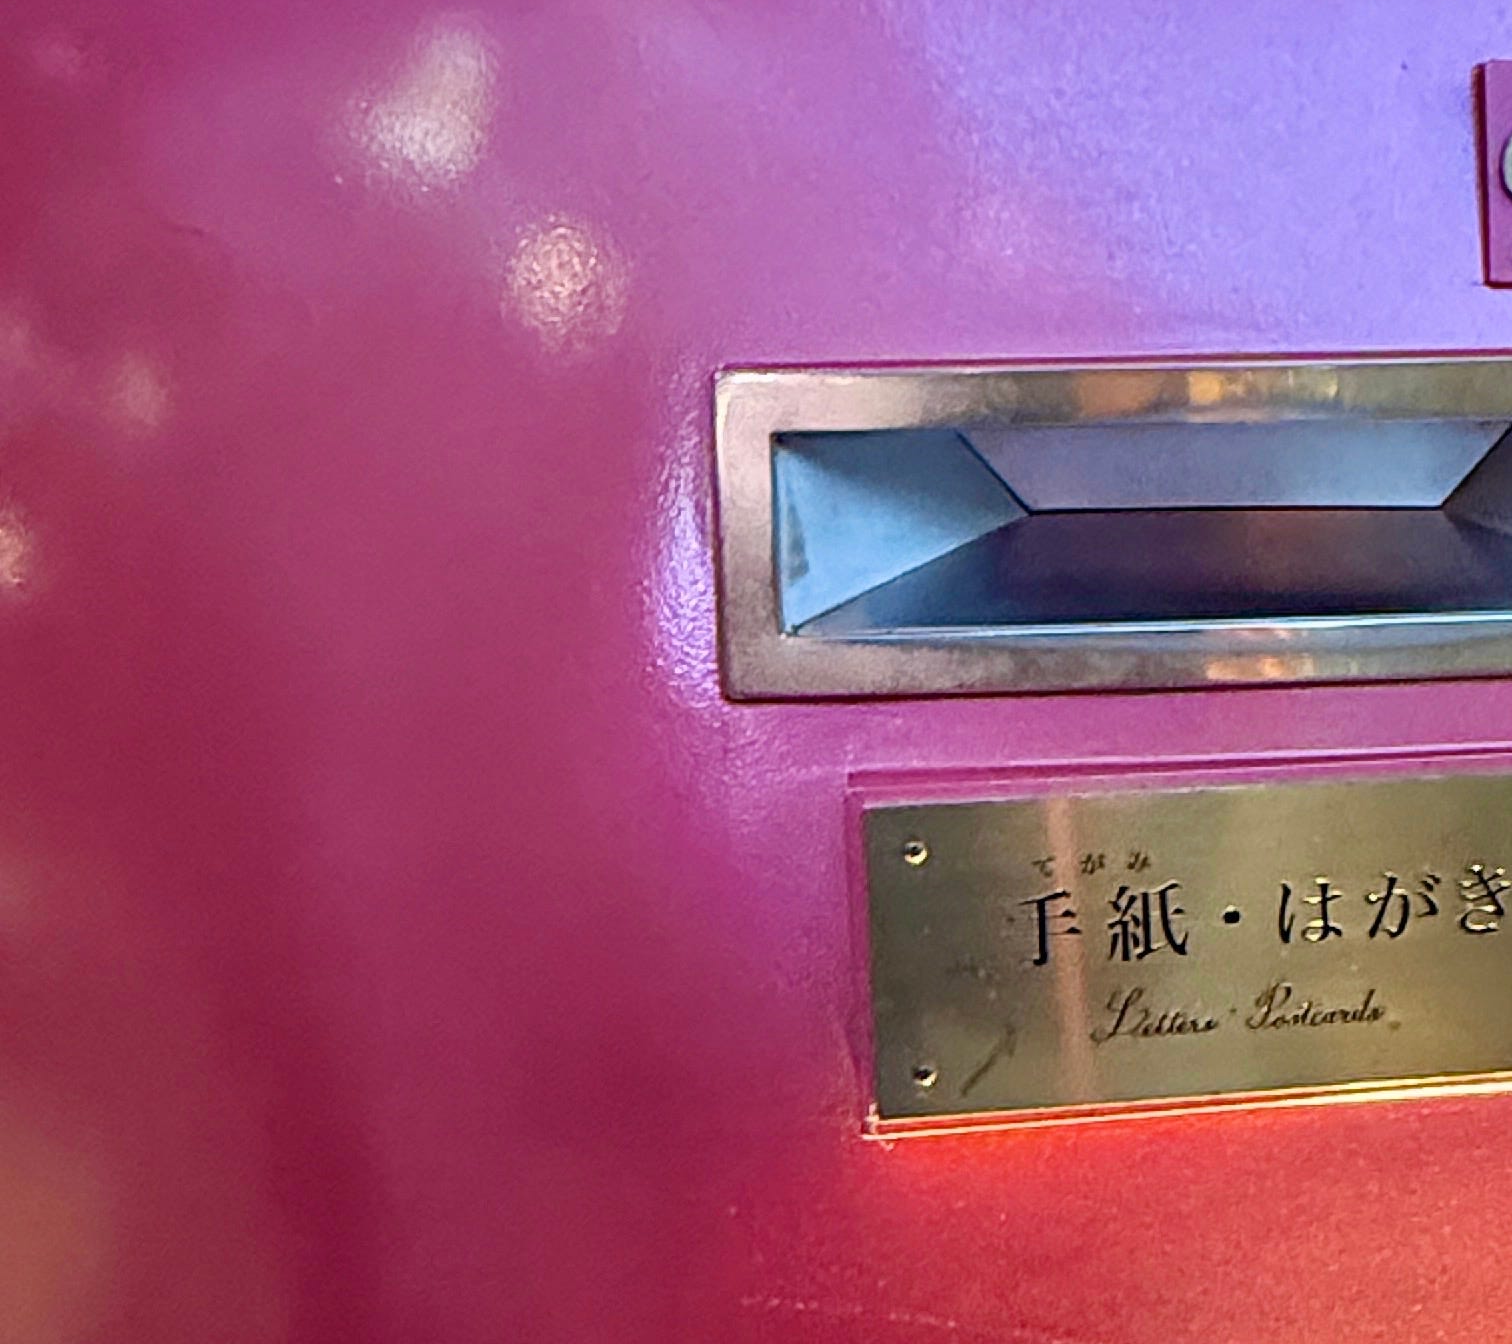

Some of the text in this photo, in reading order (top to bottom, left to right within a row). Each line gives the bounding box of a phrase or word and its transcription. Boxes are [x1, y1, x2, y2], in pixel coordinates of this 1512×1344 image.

[1018, 861, 1512, 966] 手紙・はがき
